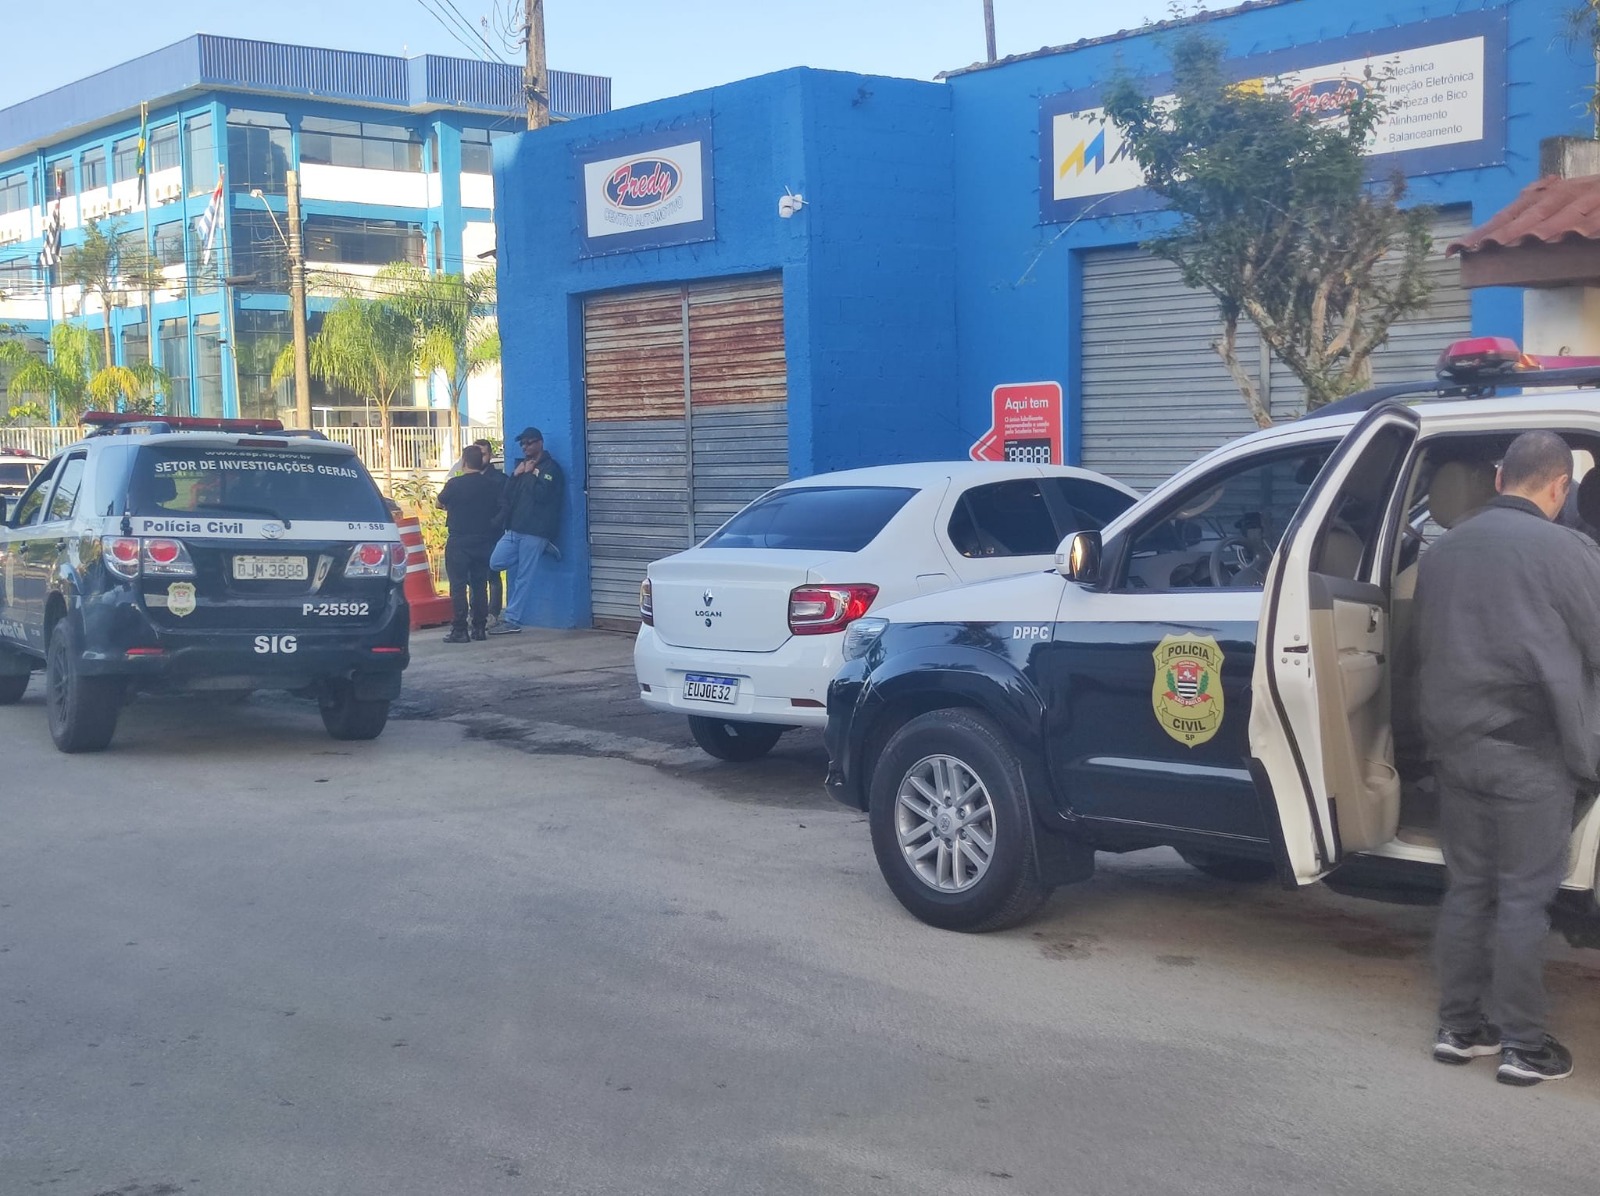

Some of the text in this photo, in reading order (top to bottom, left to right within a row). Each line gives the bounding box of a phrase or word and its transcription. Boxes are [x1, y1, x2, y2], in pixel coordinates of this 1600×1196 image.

[1389, 72, 1474, 95] Injeção Eletrônica
[1431, 93, 1444, 103] de
[1446, 89, 1468, 101] Bico
[1388, 110, 1448, 127] Alinhamento
[1388, 124, 1463, 143] Balanceamento
[613, 162, 672, 208] Fredy
[1005, 397, 1049, 413] Aqui tem
[155, 460, 358, 479] SETOR DE INVESTIGAÇÕES GERAIS
[143, 520, 244, 534] Polícia Civil
[302, 603, 369, 616] P-25592
[1013, 626, 1049, 640] DPPC
[253, 635, 298, 654] SIG
[1168, 642, 1210, 660] POLÍCIA
[1172, 718, 1206, 732] CIVIL
[1185, 733, 1195, 741] SP
